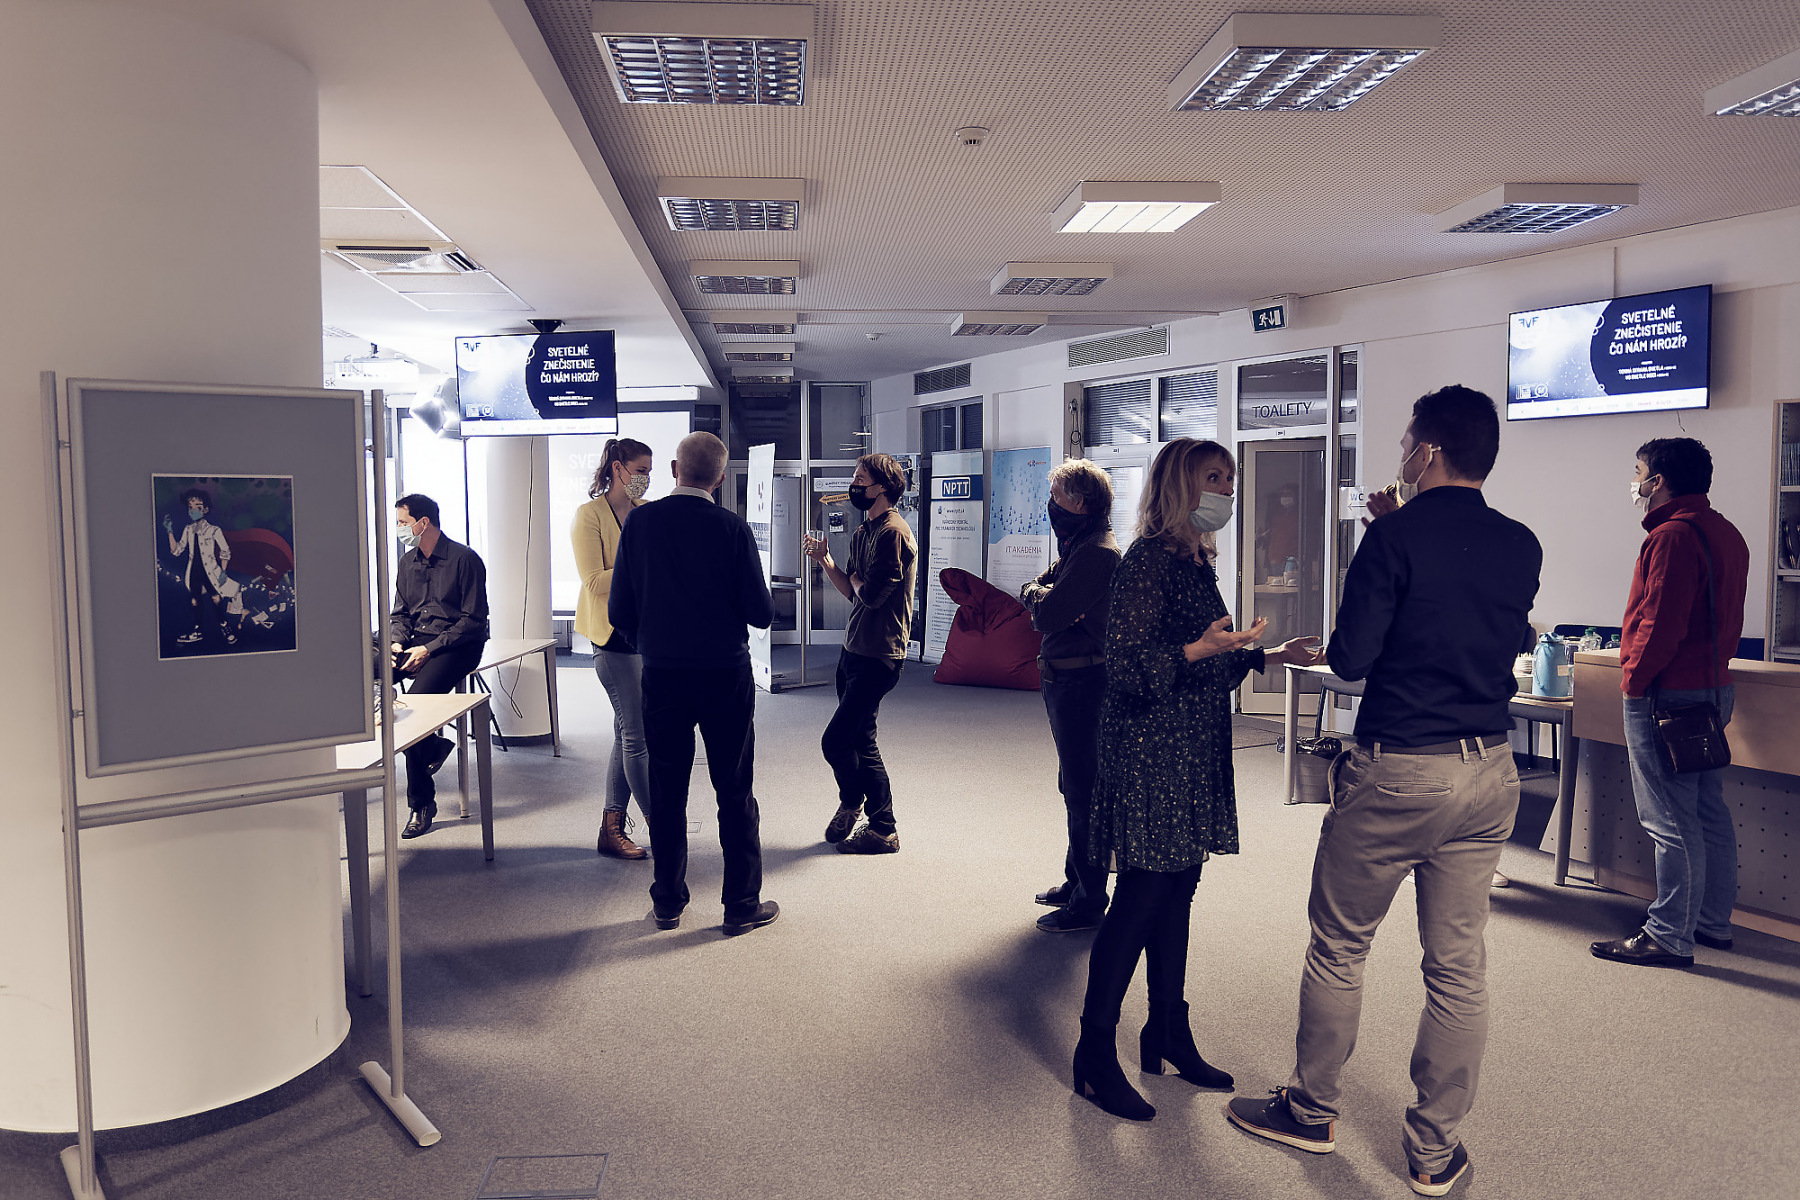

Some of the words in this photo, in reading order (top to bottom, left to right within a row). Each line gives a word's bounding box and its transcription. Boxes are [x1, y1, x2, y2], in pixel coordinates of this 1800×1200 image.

[1621, 303, 1676, 325] SVETELNÉ
[1614, 321, 1683, 340] ZNEČISTENIE
[547, 343, 590, 357] SVETELNÉ
[1609, 341, 1624, 356] ČO
[1625, 338, 1648, 354] NÁM
[1649, 335, 1688, 352] HROZÍ?
[543, 358, 595, 371] ZNEČISTENIE
[540, 371, 551, 384] ČO
[553, 370, 570, 383] NÁM
[571, 369, 600, 383] HROZÍ?
[1252, 401, 1312, 419] TOALETY
[943, 481, 969, 495] NPTT
[1350, 493, 1364, 501] WC
